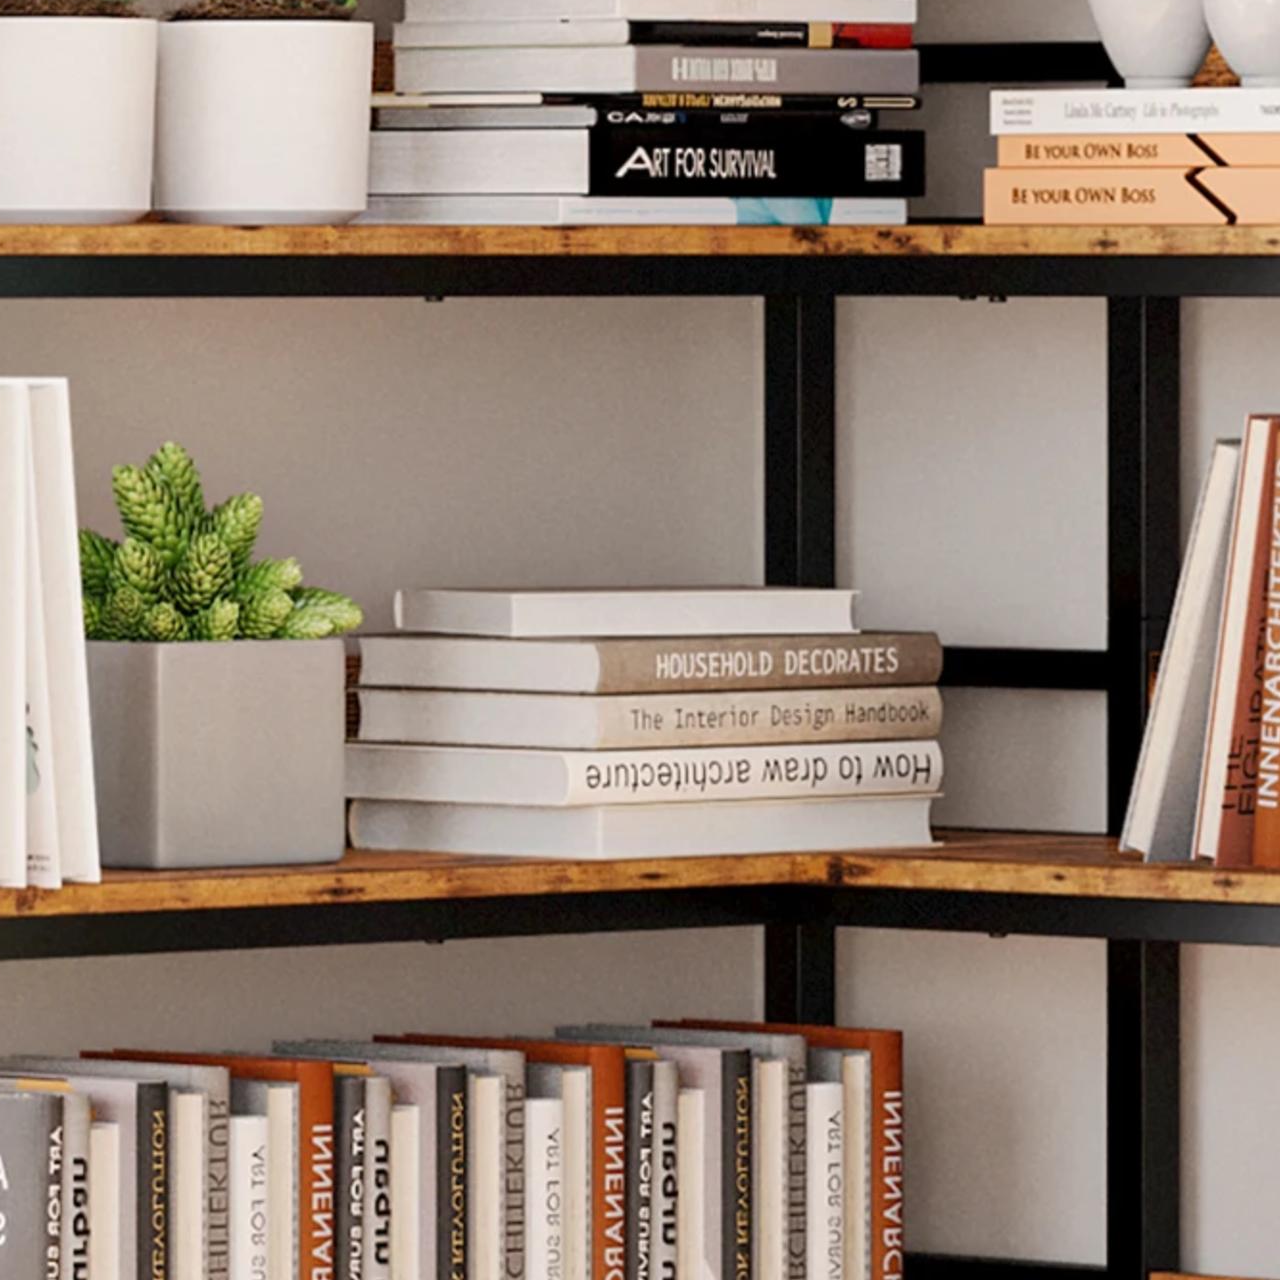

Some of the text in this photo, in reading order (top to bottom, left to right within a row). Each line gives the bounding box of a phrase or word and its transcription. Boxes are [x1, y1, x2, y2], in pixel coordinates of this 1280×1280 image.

[675, 148, 705, 177] FOR
[709, 149, 776, 179] SURVIVAL
[1083, 144, 1121, 159] OWN
[1075, 187, 1116, 203] OWN
[656, 647, 899, 679] HOUSEHOLD DECORATES
[631, 699, 931, 730] The Interior Design Handbook
[586, 754, 931, 793] How to draw architecture
